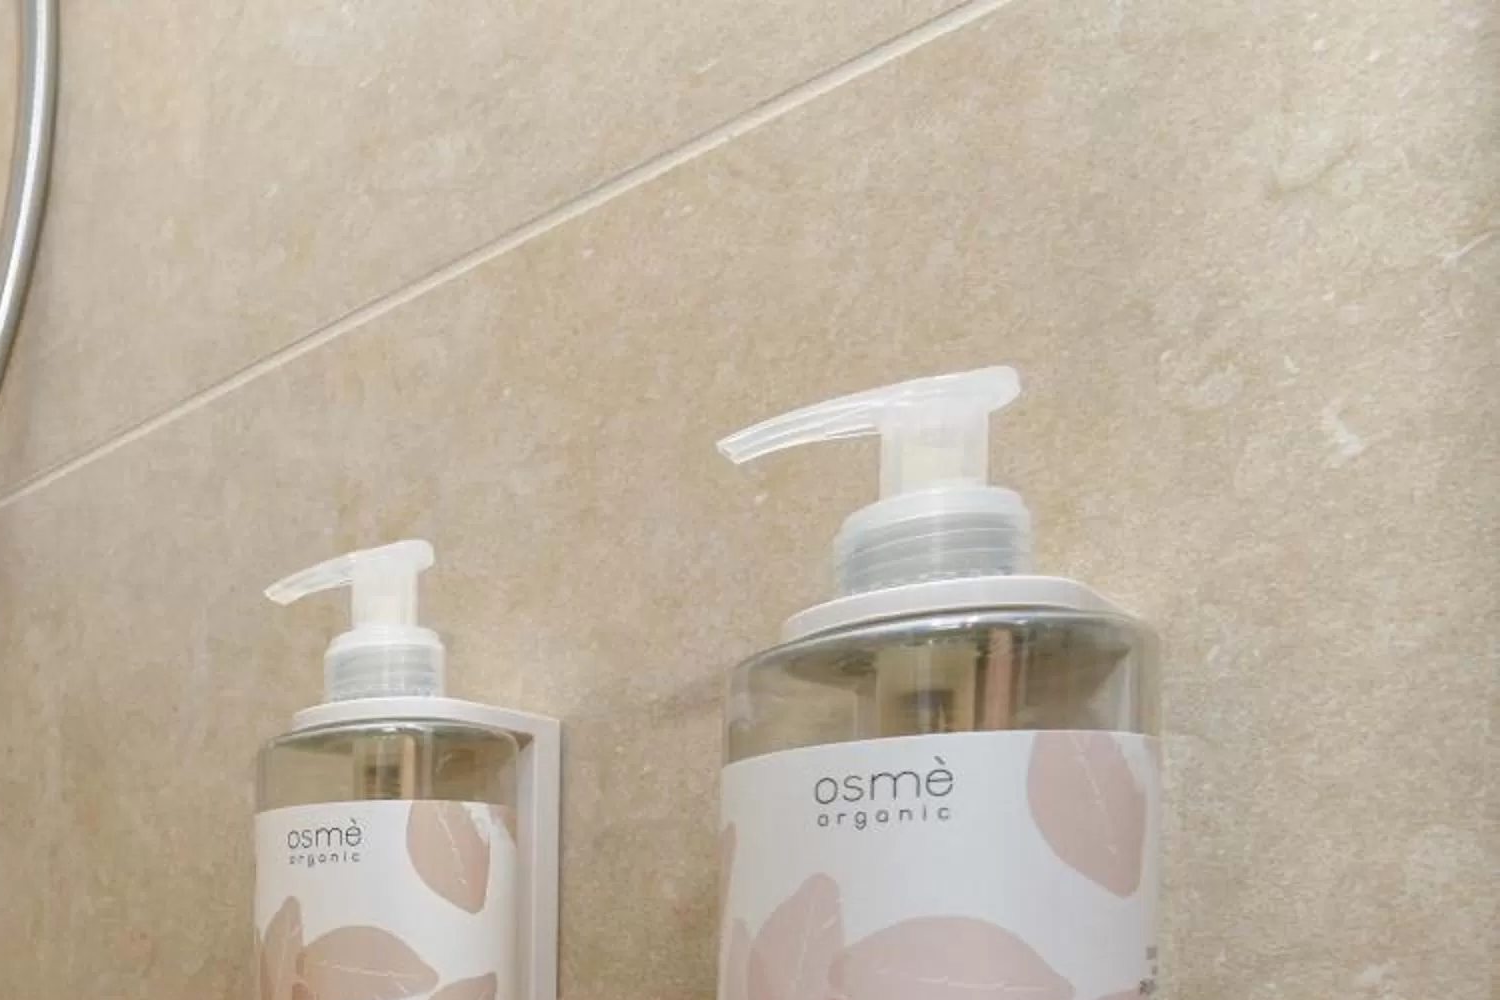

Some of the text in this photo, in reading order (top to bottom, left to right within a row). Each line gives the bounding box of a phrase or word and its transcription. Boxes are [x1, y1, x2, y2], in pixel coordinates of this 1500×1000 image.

[814, 755, 954, 805] osmè
[817, 806, 951, 830] organic
[287, 818, 362, 850] osmè
[289, 852, 361, 868] organic
